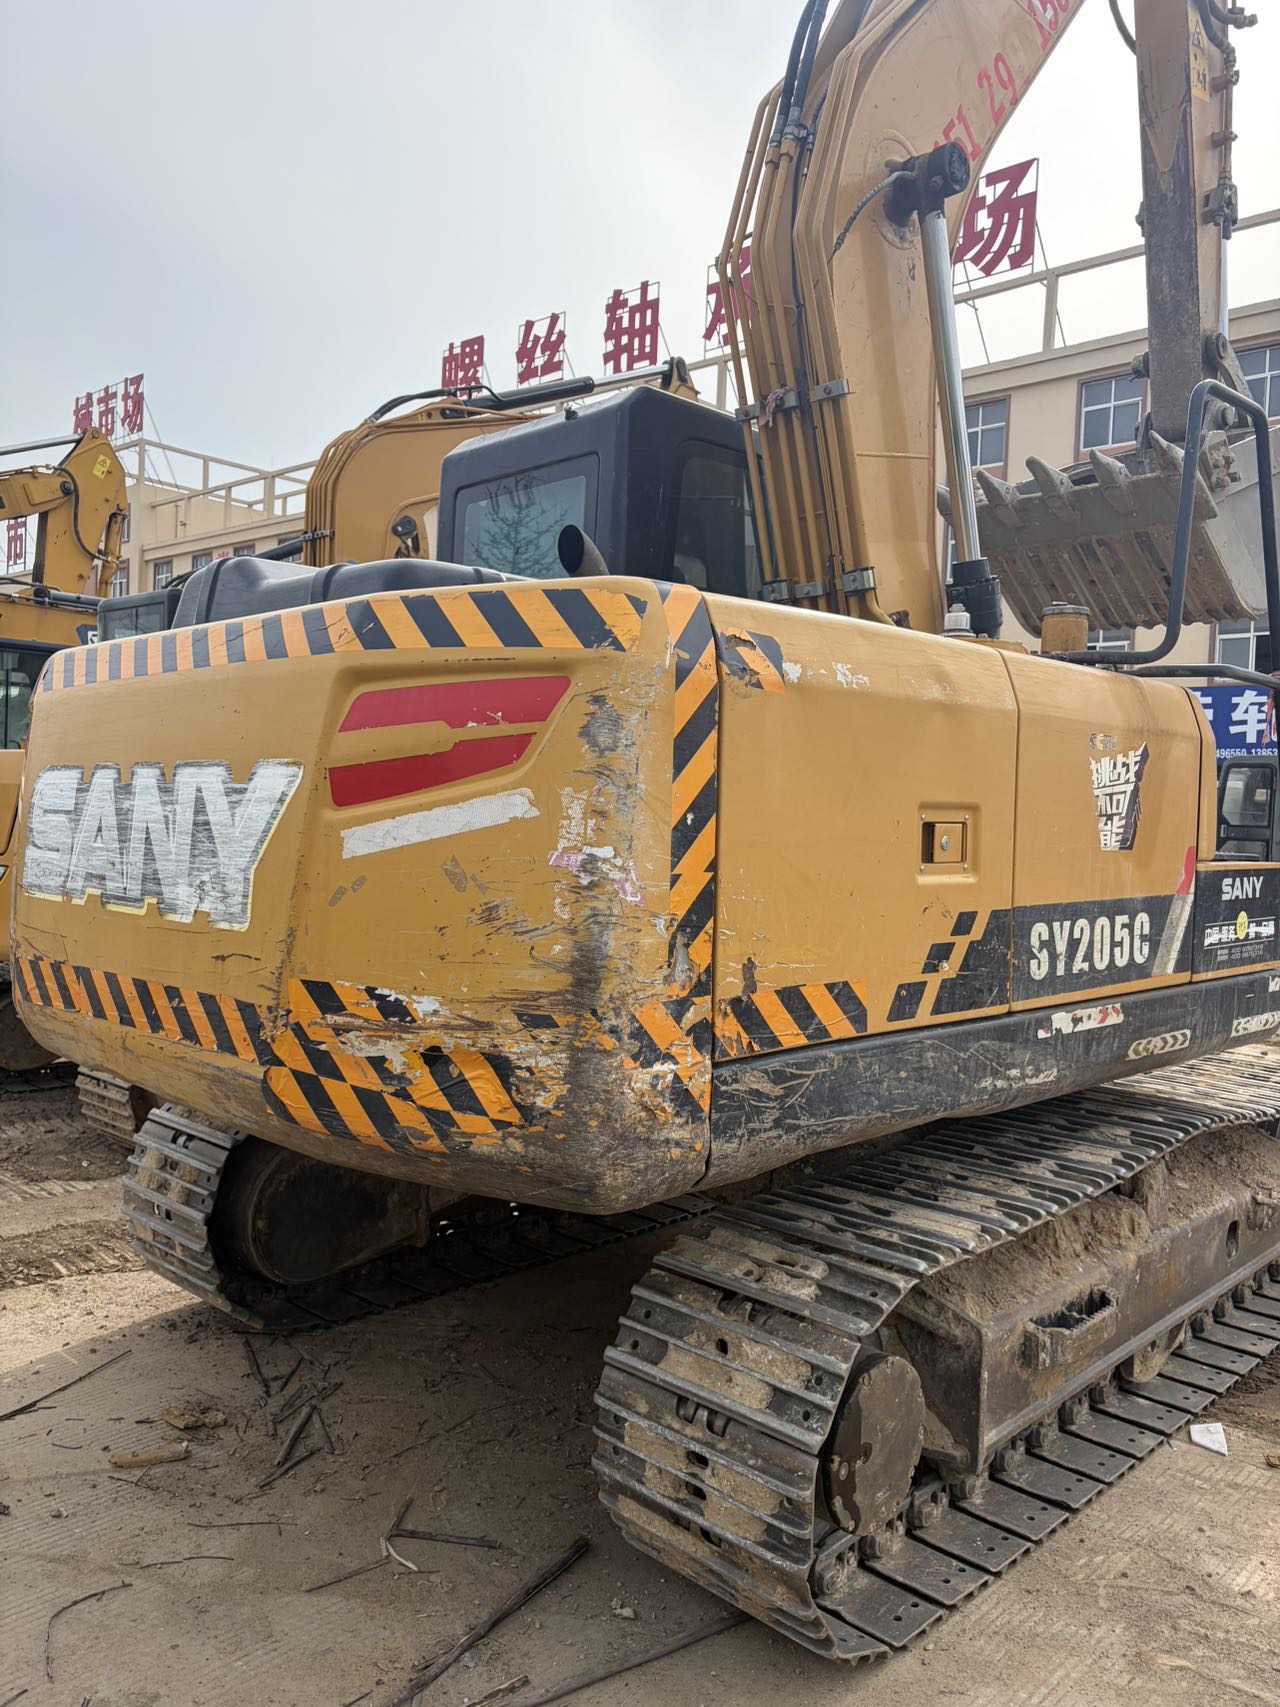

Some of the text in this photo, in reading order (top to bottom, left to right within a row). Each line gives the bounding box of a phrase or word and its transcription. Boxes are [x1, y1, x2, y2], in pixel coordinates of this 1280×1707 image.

[953, 158, 1038, 277] 场
[24, 759, 304, 931] SANY
[1221, 876, 1264, 901] SANY
[1030, 912, 1150, 981] SY205C
